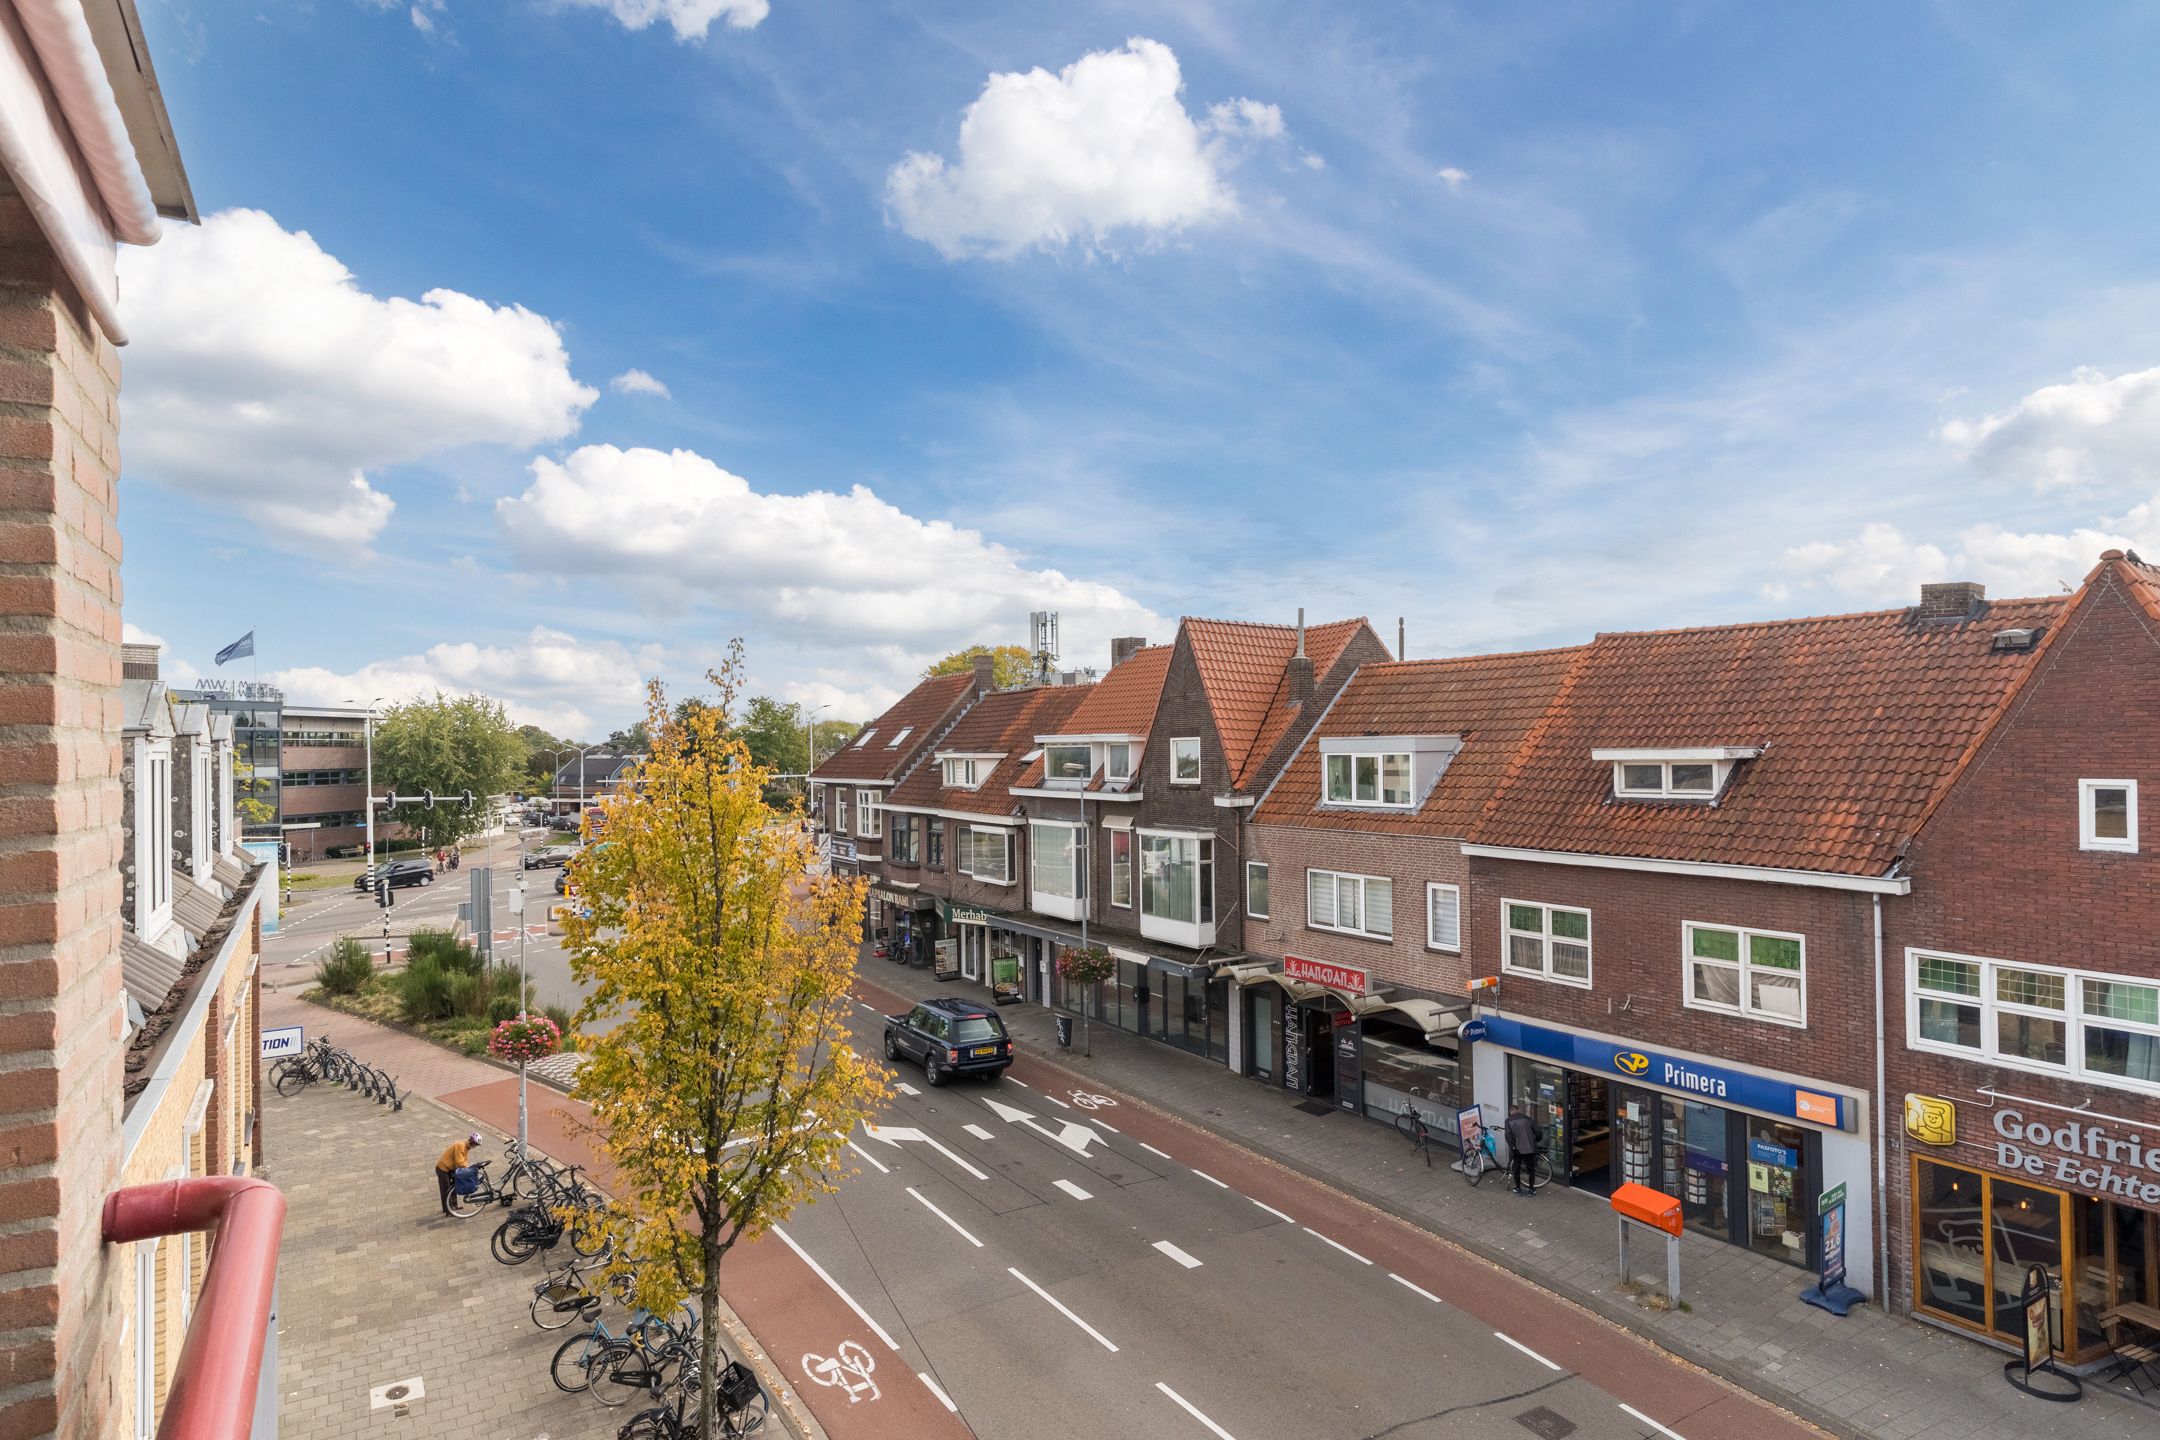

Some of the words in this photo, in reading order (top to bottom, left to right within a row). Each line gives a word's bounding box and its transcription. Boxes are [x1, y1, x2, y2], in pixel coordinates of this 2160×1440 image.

[262, 1037, 290, 1050] TION
[1664, 1062, 1727, 1097] Primera
[1995, 1140, 2044, 1176] De
[2054, 1156, 2160, 1204] Echte
